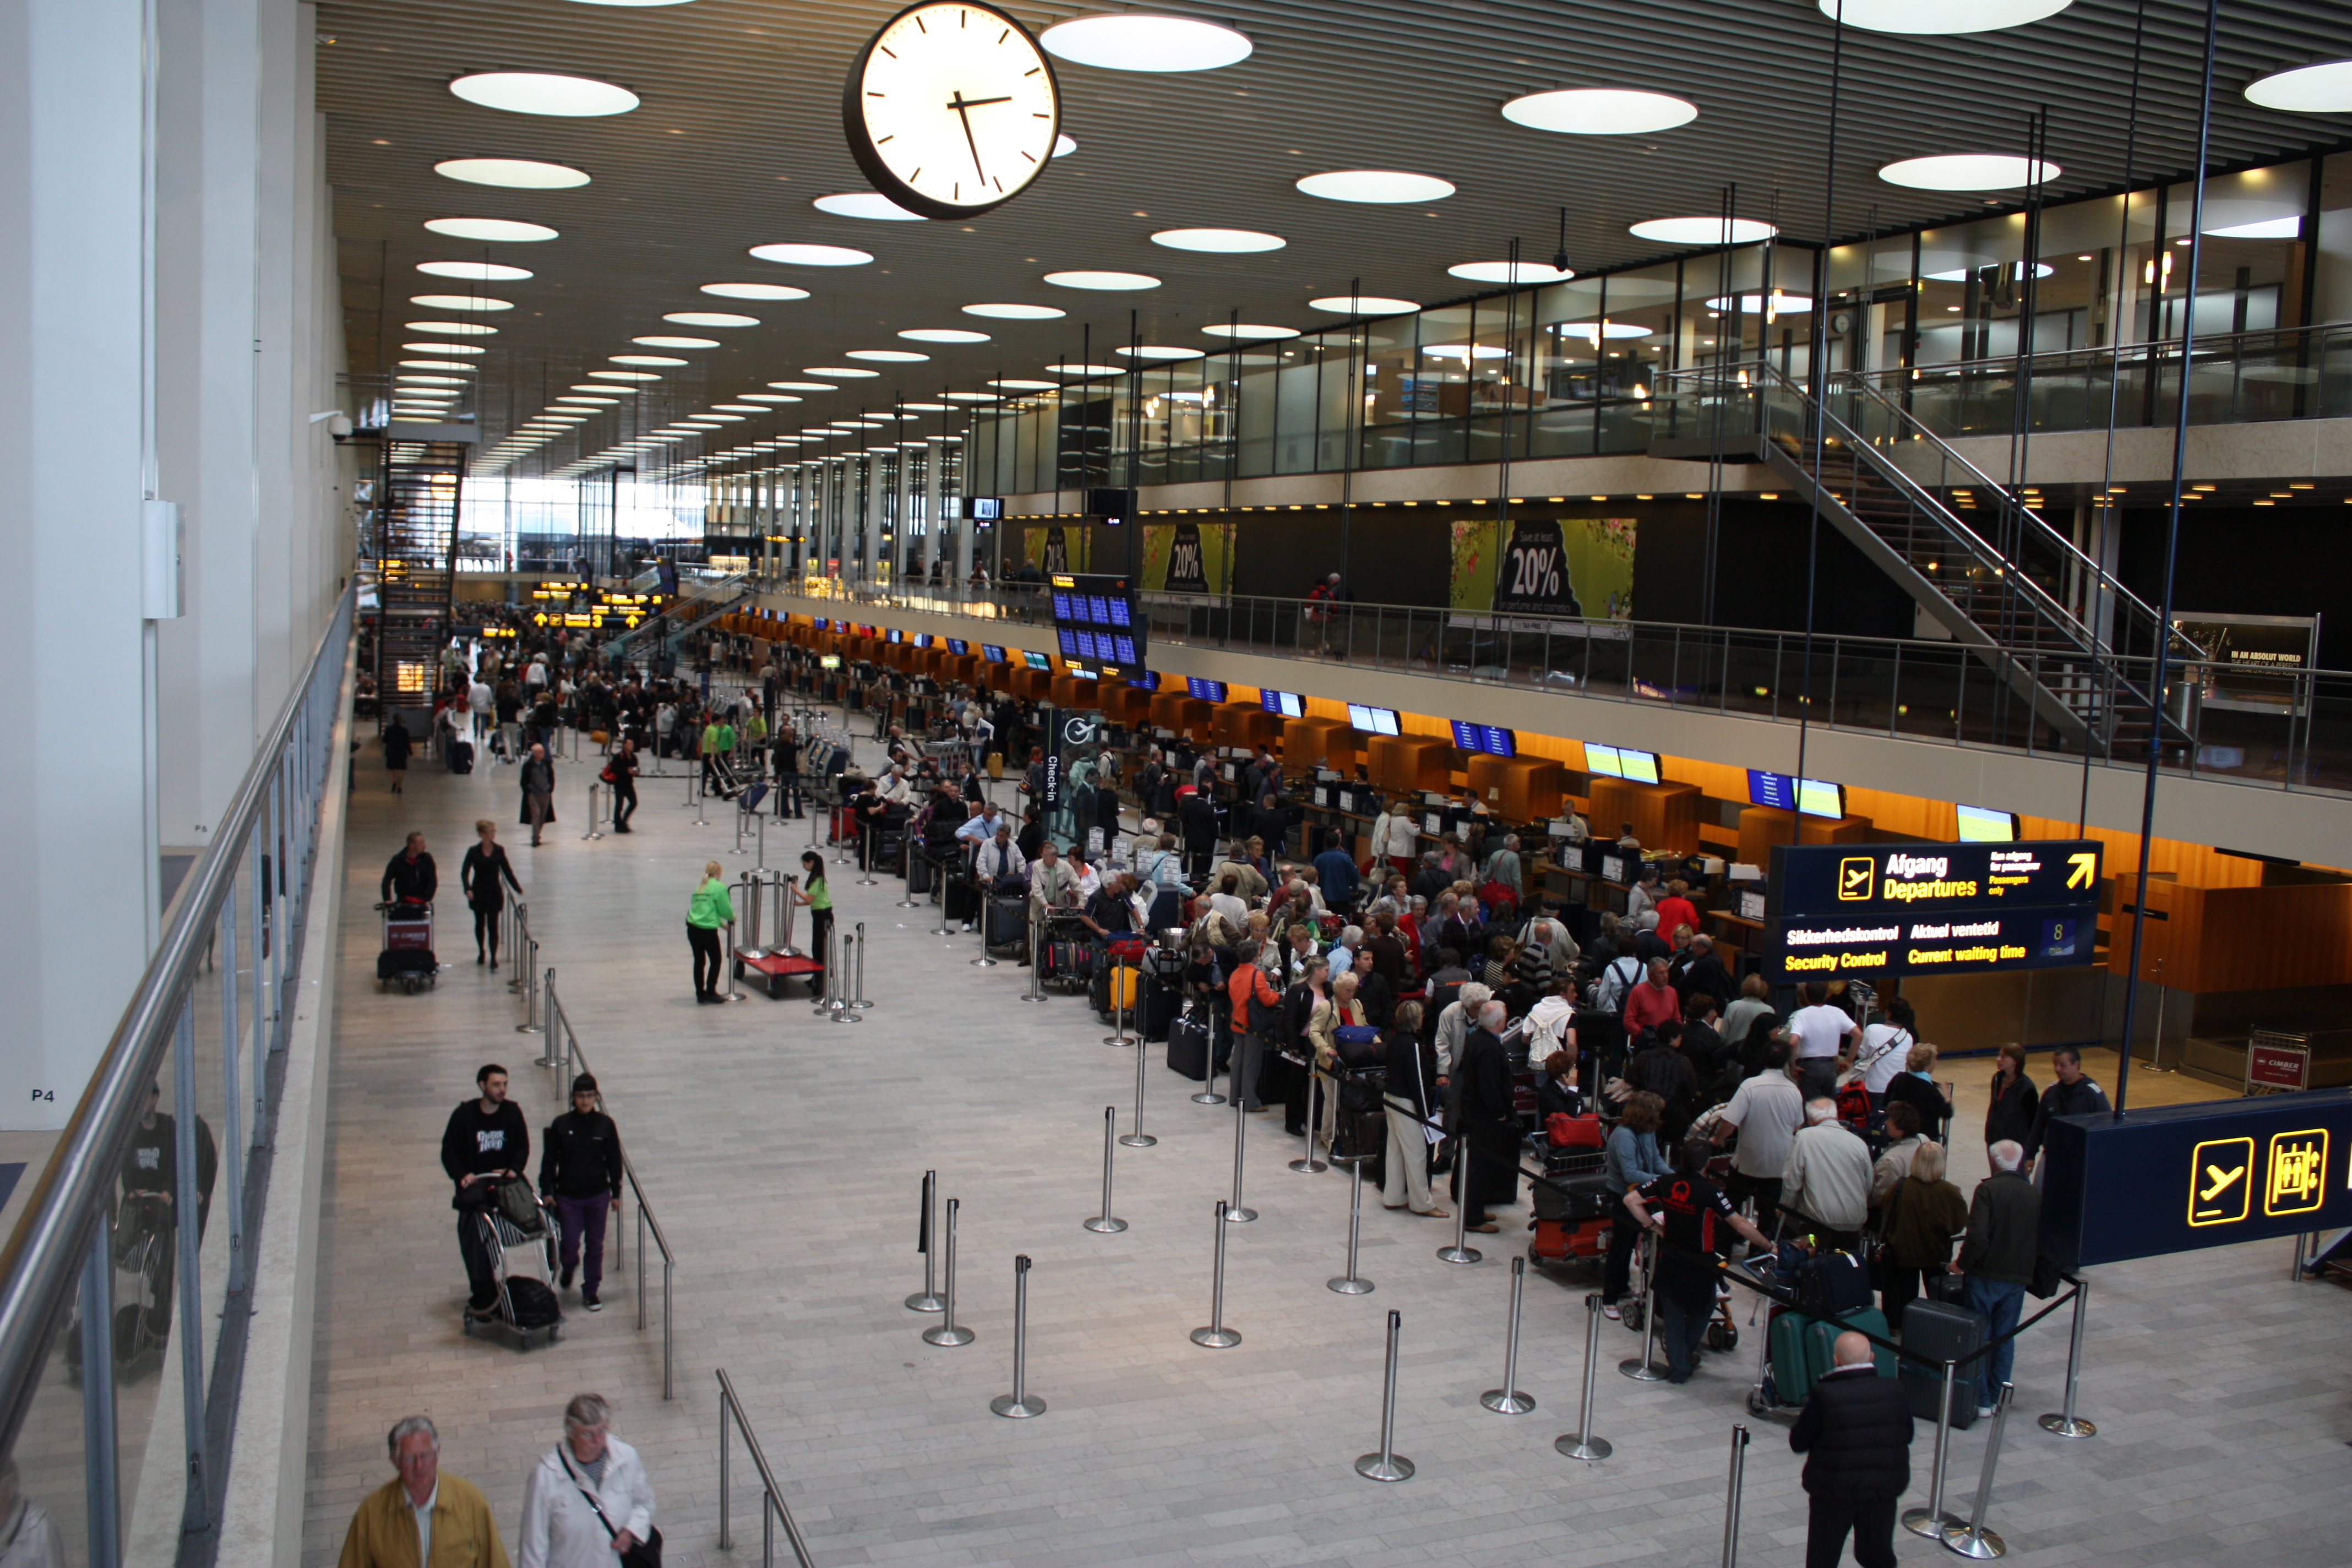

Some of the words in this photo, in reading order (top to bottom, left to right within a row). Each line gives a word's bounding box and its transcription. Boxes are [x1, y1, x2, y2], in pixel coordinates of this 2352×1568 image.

[1174, 543, 1199, 579] 20%
[1511, 547, 1559, 596] 20%
[592, 614, 602, 628] 3
[2250, 652, 2277, 661] ABSOLUT
[2278, 654, 2301, 662] WORLD
[1047, 756, 1058, 801] Check-in
[1990, 852, 2005, 861] Kun
[2006, 851, 2033, 862] adgang
[1886, 854, 1948, 878] Afgang
[1990, 862, 2002, 872] for
[1989, 875, 2029, 885] Passengers
[1884, 878, 1977, 903] Departures
[1988, 886, 2004, 896] only
[1787, 925, 1899, 945] Sikkerhedskontrol
[1910, 923, 1950, 939] Aktuel
[1952, 921, 2000, 937] ventetid
[2054, 924, 2062, 940] 8
[1785, 954, 1838, 972] Security
[1841, 951, 1887, 968] Control
[1908, 949, 1952, 964] Current
[1955, 946, 1997, 962] waiting
[2000, 945, 2026, 959] time
[2269, 1060, 2299, 1069] CIMBER
[32, 1090, 55, 1102] P4
